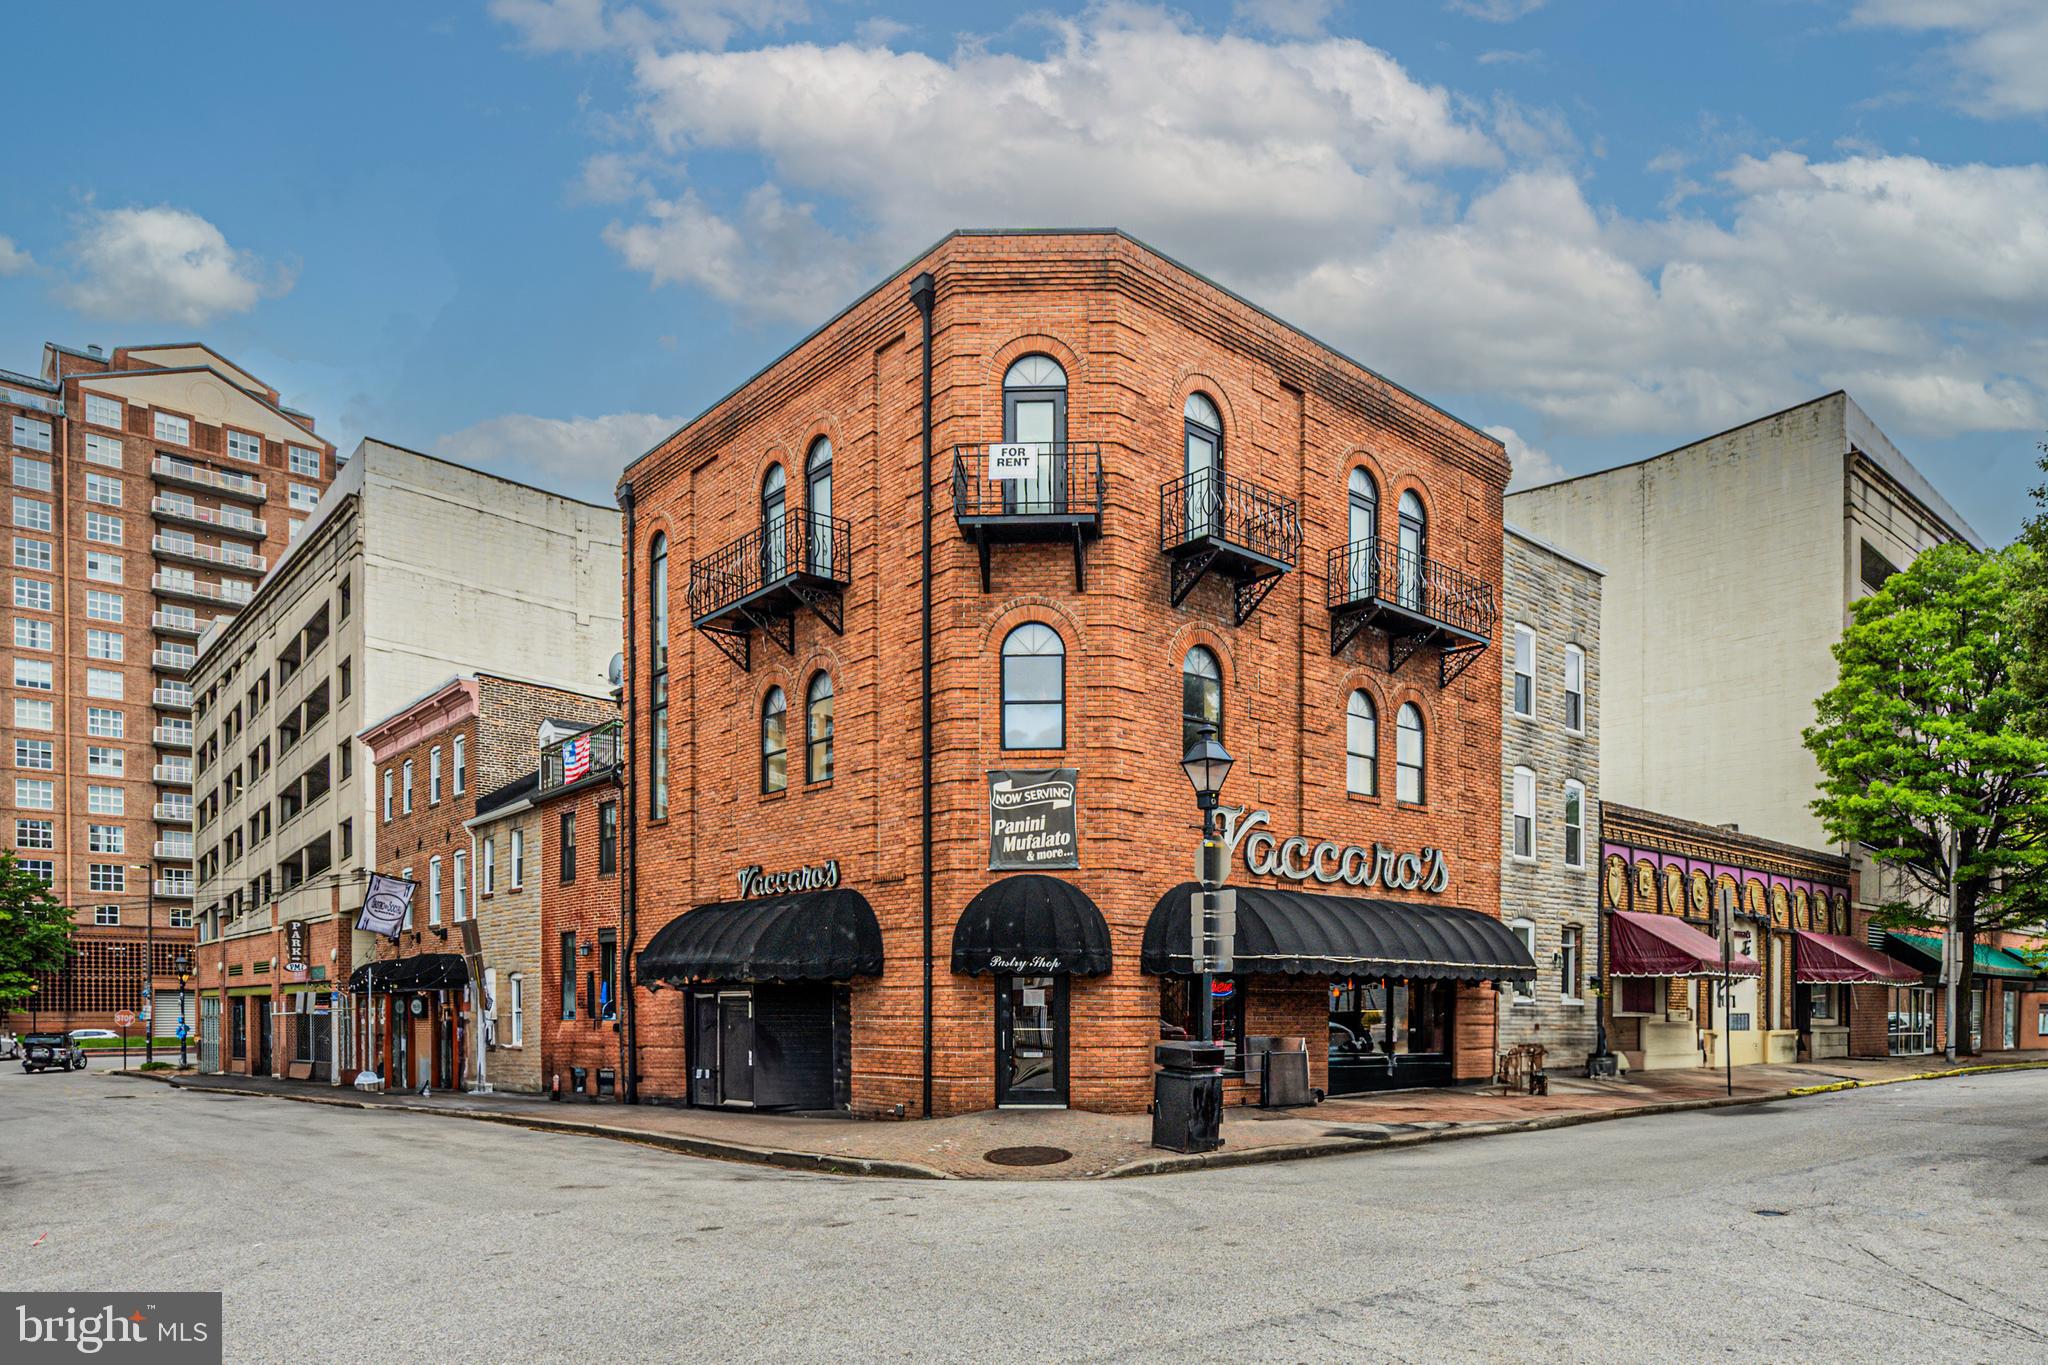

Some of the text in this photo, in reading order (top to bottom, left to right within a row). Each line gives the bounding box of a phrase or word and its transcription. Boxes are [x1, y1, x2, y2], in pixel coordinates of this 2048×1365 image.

[1002, 447, 1026, 457] FOR
[997, 457, 1030, 467] RENT
[996, 787, 1070, 805] NOW SERVING
[994, 814, 1046, 836] Panini
[1003, 830, 1071, 853] Mufalato
[1212, 804, 1450, 894] Vaccaro's
[1026, 848, 1074, 862] & more...
[737, 860, 839, 900] Vaccaro's
[291, 921, 302, 956] PARK
[990, 955, 1061, 972] Pastry Shop
[115, 1014, 134, 1023] STOP
